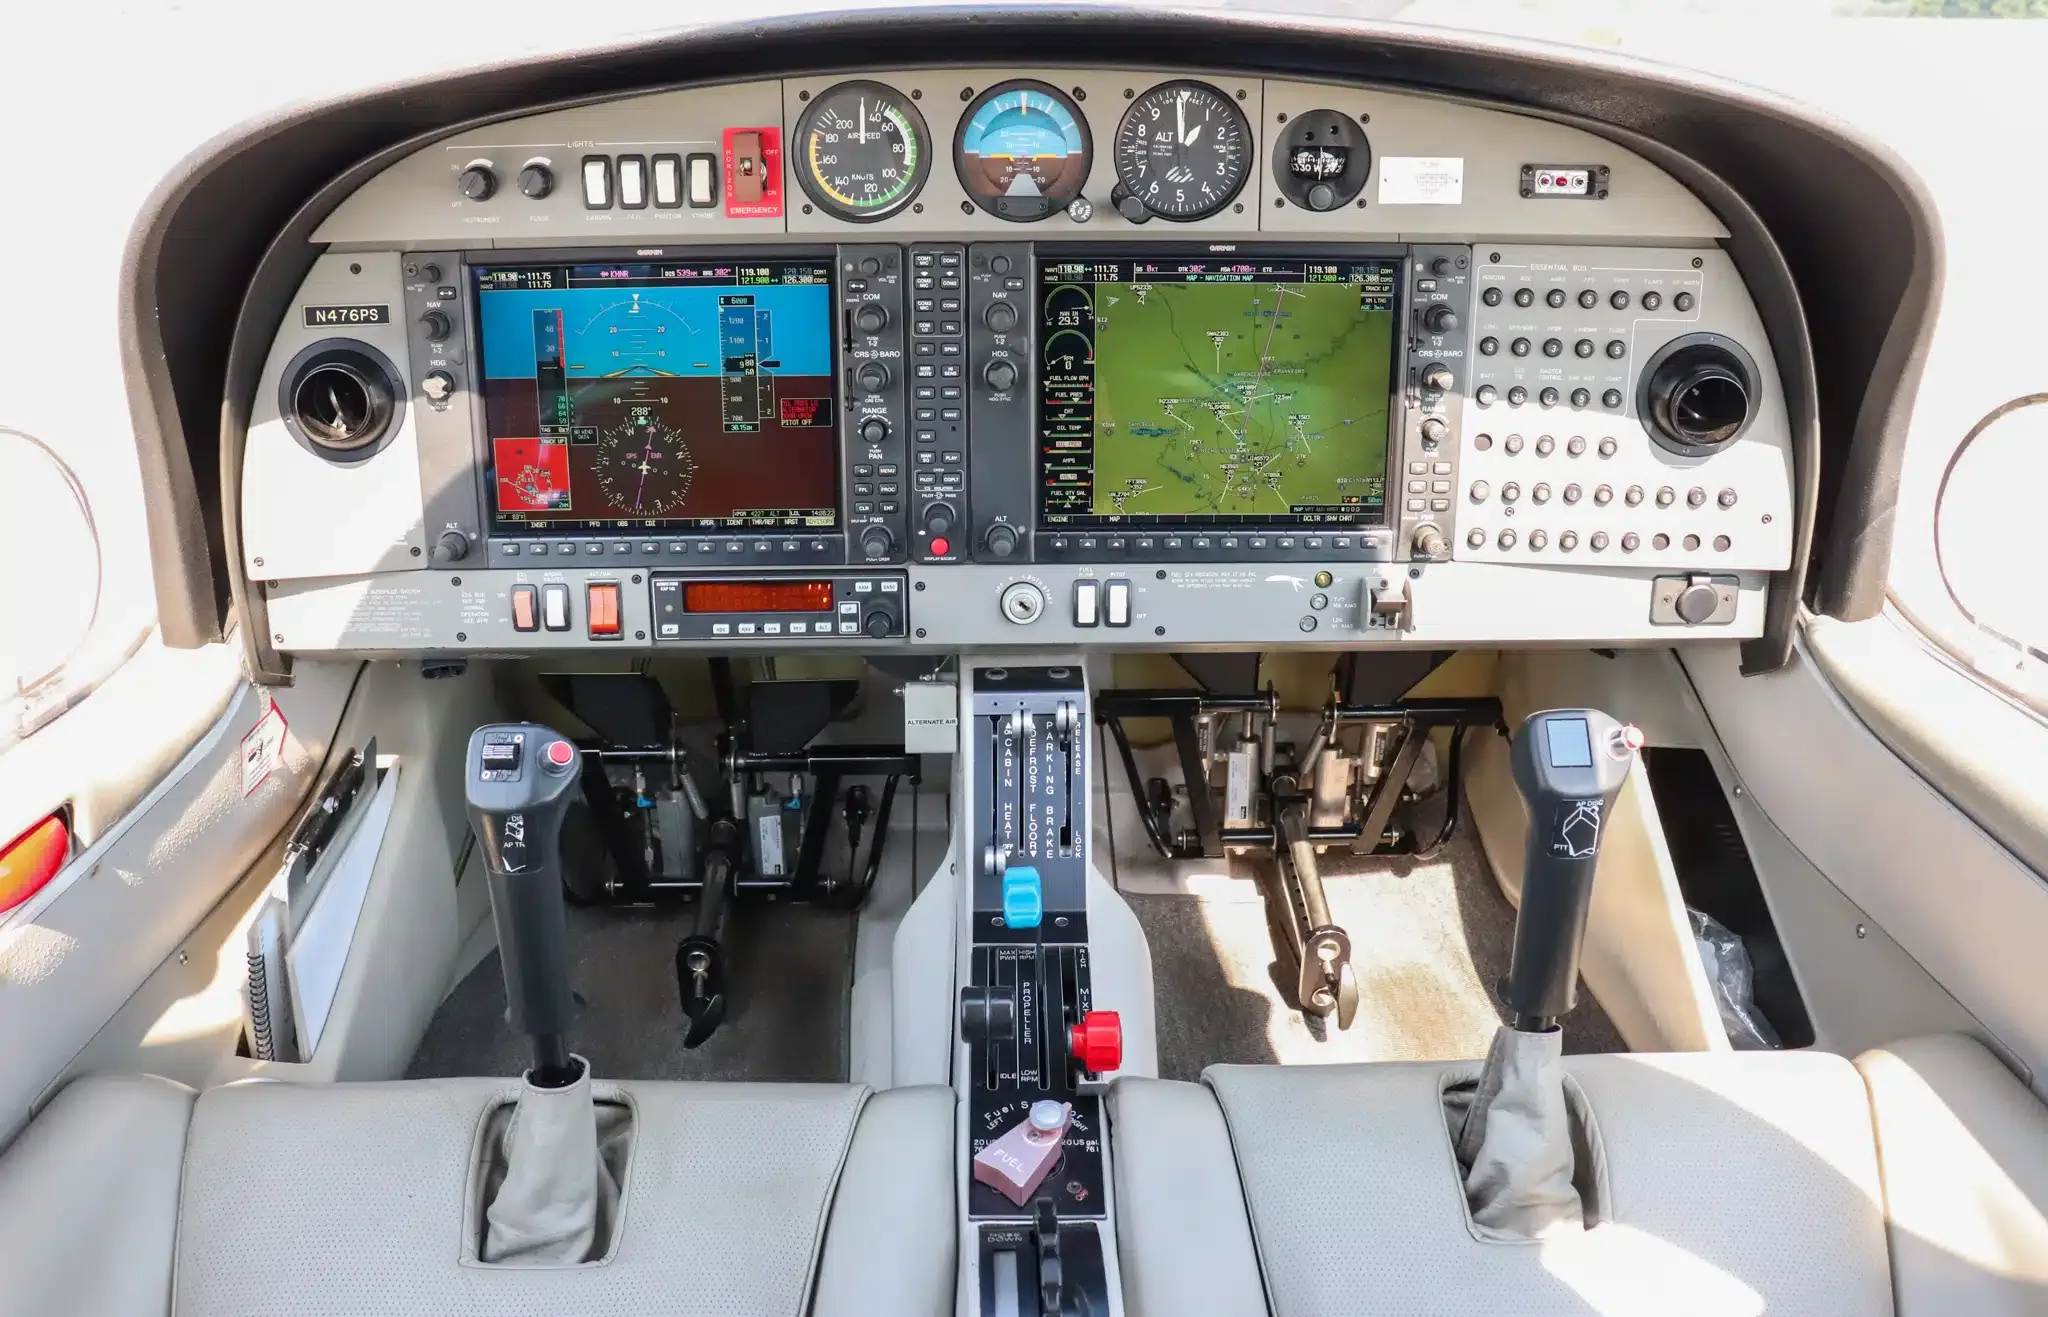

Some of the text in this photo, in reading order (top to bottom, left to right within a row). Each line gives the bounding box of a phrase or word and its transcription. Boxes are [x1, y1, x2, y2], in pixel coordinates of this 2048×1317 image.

[869, 113, 882, 123] 40
[1151, 108, 1160, 120] 9
[835, 119, 853, 130] 200
[881, 122, 894, 132] 60
[1138, 124, 1146, 136] 8
[825, 133, 838, 143] 180
[1155, 132, 1173, 142] ALT
[1217, 127, 1225, 139] 2
[567, 140, 594, 148] LIGHTS
[892, 143, 904, 152] 80
[823, 155, 837, 165] 160
[725, 150, 733, 198] HORIZON
[882, 168, 896, 178] 100
[1138, 166, 1146, 178] 7
[1216, 163, 1225, 175] 3
[835, 176, 849, 186] 140
[851, 173, 874, 181] KNOTS
[864, 183, 878, 193] 120
[1150, 181, 1159, 193] 6
[1201, 182, 1211, 193] 4
[1176, 190, 1184, 201] 5
[610, 270, 629, 278] KHNR
[741, 268, 769, 276] 119.100
[1094, 265, 1118, 273] 111.75
[527, 272, 551, 280] 111.75
[316, 308, 379, 322] N476PS
[1058, 317, 1079, 326] 29.3
[631, 407, 651, 416] 288°
[1029, 730, 1037, 793] DEFROST
[1004, 738, 1012, 839] CABIN HEAT
[1046, 721, 1054, 859] PARKING BRAKE
[1029, 804, 1037, 850] FLOOR
[1080, 988, 1090, 1022] MIXT
[1023, 982, 1031, 1044] PROPELLER
[984, 1103, 1015, 1121] Fuel
[986, 1116, 1004, 1130] LEFT
[993, 1148, 1025, 1173] FUEL
[1076, 1189, 1089, 1201] OFF
